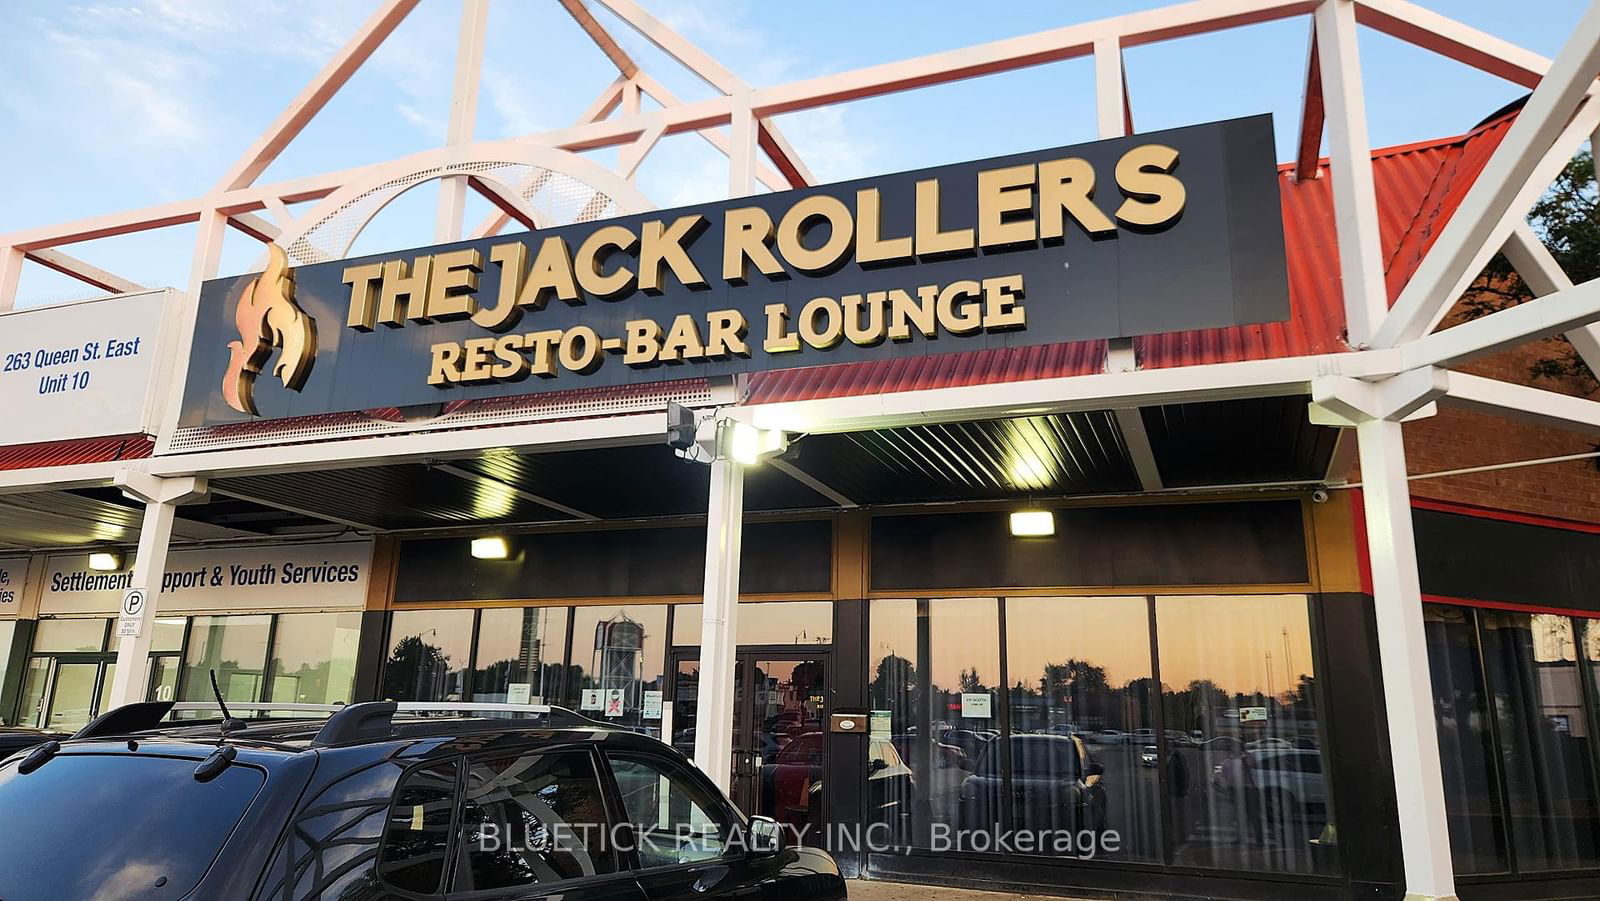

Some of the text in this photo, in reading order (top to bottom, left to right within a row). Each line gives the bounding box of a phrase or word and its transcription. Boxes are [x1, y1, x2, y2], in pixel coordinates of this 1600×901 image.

[343, 144, 1187, 332] THE JACK ROLLERS
[427, 274, 1027, 388] RESTO-BAR LOUNGE
[3, 336, 141, 372] 263 Queen St. East
[39, 370, 90, 395] Unit 10
[51, 561, 359, 593] Settlement pport & Youth Services
[129, 595, 140, 611] P
[155, 684, 172, 702] 10
